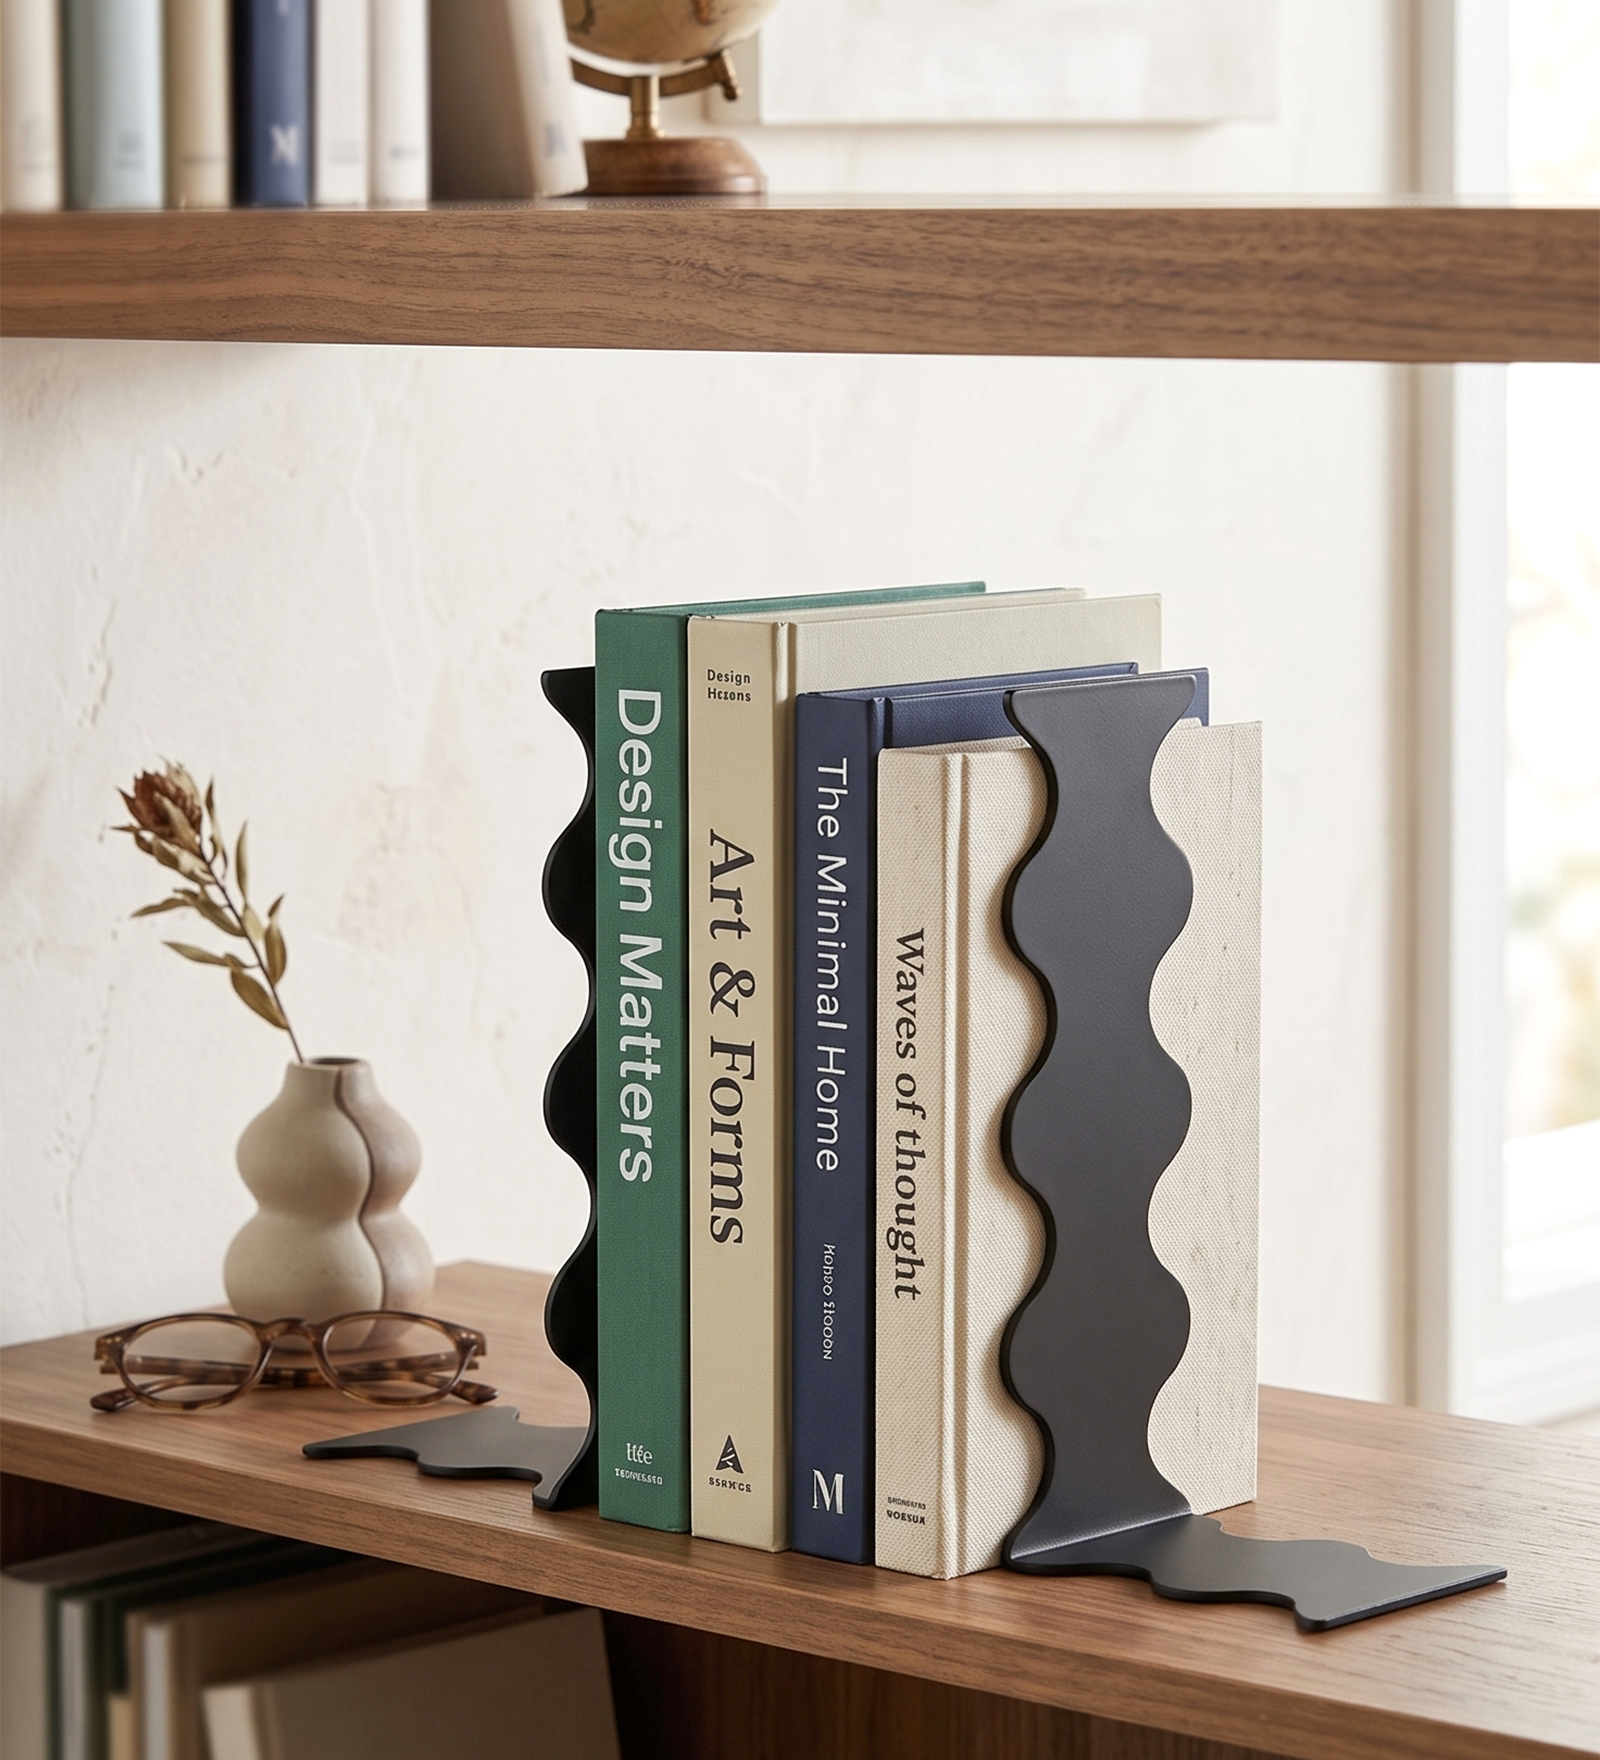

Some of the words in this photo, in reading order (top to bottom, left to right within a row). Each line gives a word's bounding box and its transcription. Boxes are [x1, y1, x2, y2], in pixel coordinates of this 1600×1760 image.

[707, 668, 751, 686] Design
[608, 689, 663, 912] Design
[817, 757, 848, 838] The
[709, 828, 755, 940] Art
[816, 854, 848, 1030] Minimal
[709, 961, 756, 1018] &
[895, 927, 925, 1059] Waves
[619, 933, 663, 1183] Matters
[816, 1045, 846, 1171] Home
[895, 1072, 927, 1121] of
[709, 1035, 755, 1244] Forms
[886, 1129, 926, 1301] thought
[812, 1469, 844, 1515] M
